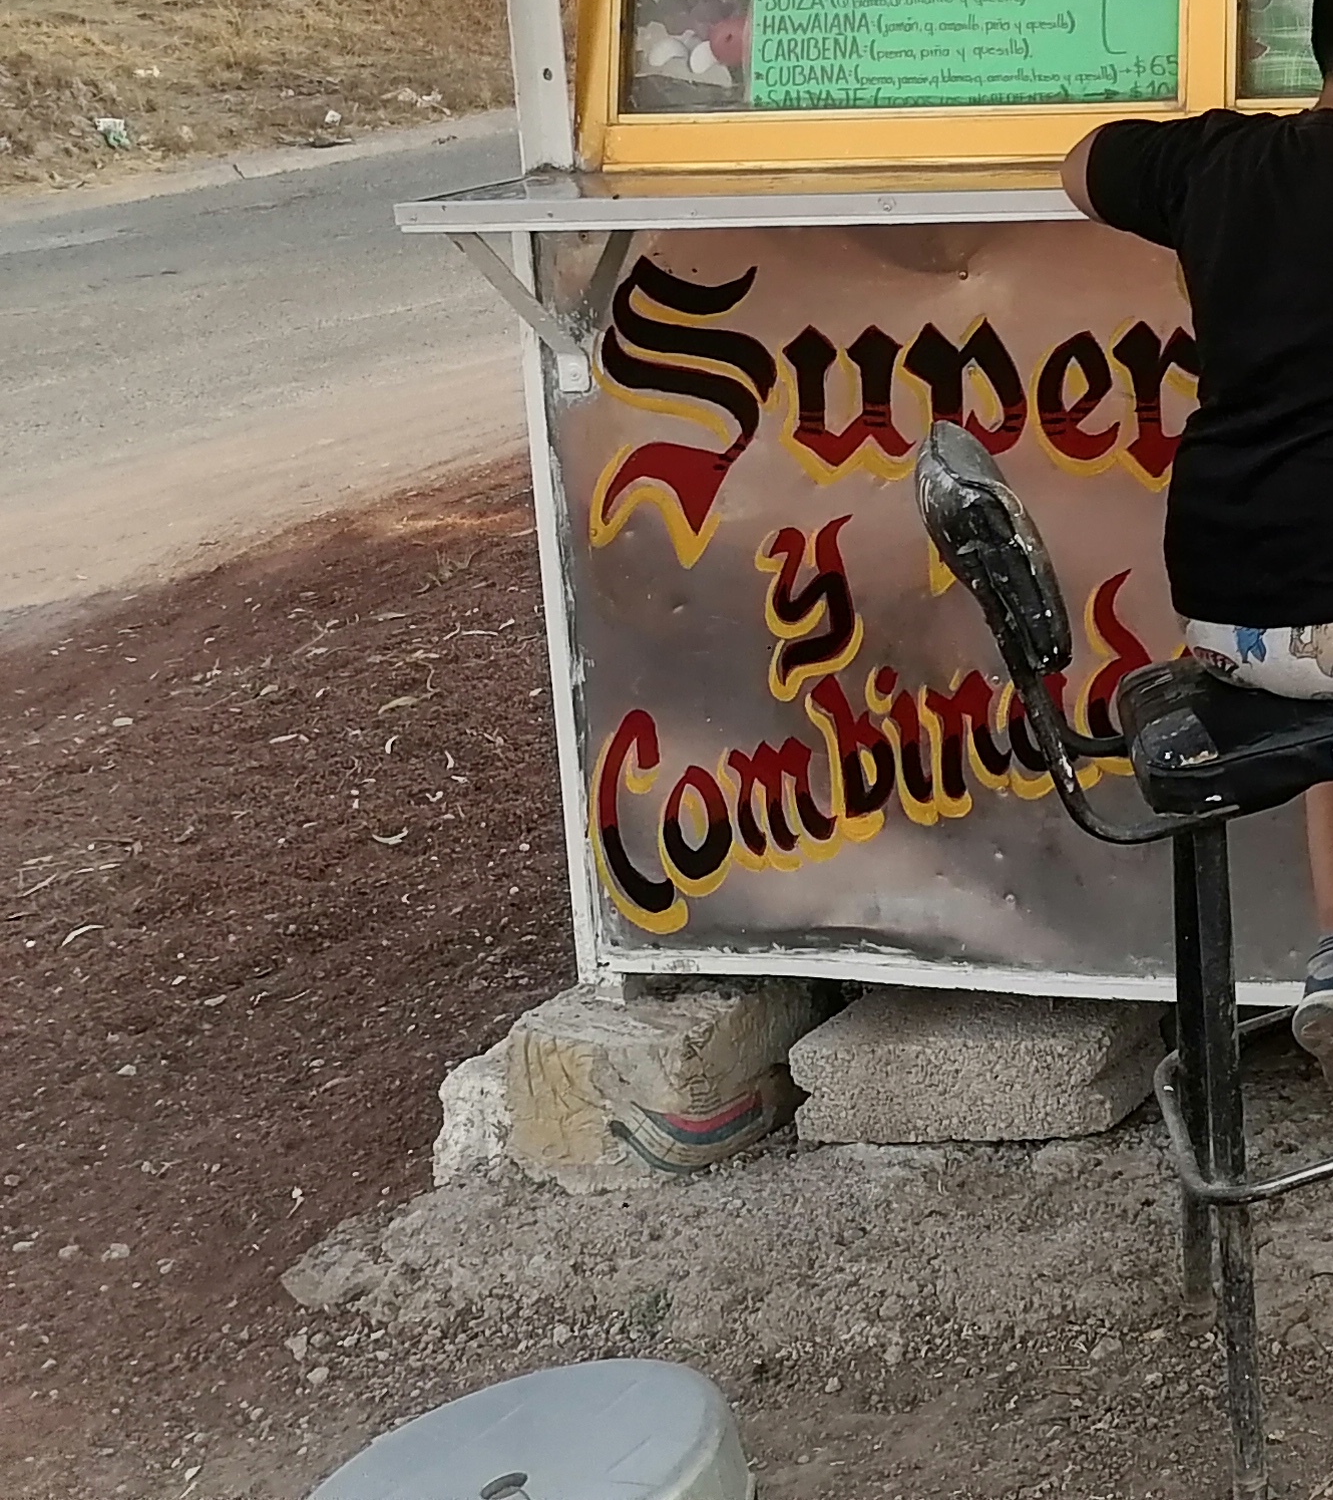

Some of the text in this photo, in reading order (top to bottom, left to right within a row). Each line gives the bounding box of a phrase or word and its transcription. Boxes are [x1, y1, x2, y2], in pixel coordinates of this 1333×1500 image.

[955, 47, 966, 62] y
[592, 255, 1200, 567] Super
[756, 512, 862, 700] y
[592, 568, 1156, 932] Combinad
